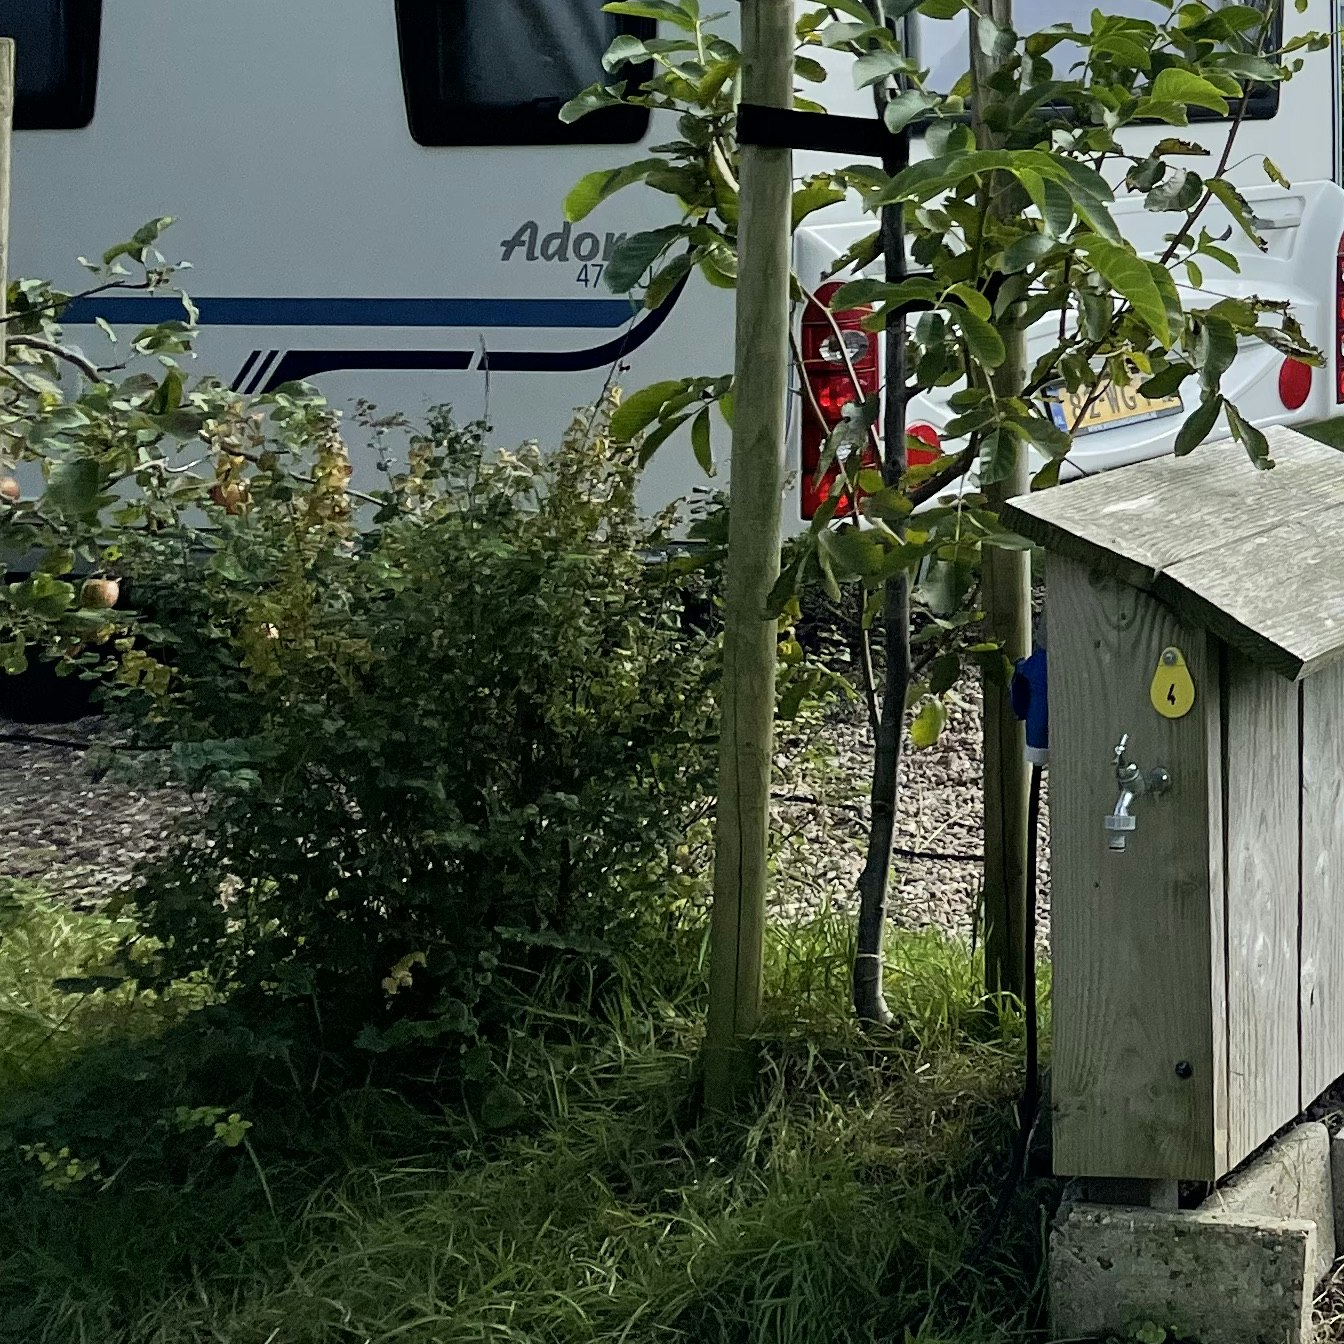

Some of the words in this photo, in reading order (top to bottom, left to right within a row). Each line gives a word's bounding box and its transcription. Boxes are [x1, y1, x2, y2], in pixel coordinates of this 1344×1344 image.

[500, 220, 628, 262] Ador
[576, 263, 604, 288] 47
[1166, 683, 1177, 706] 4
